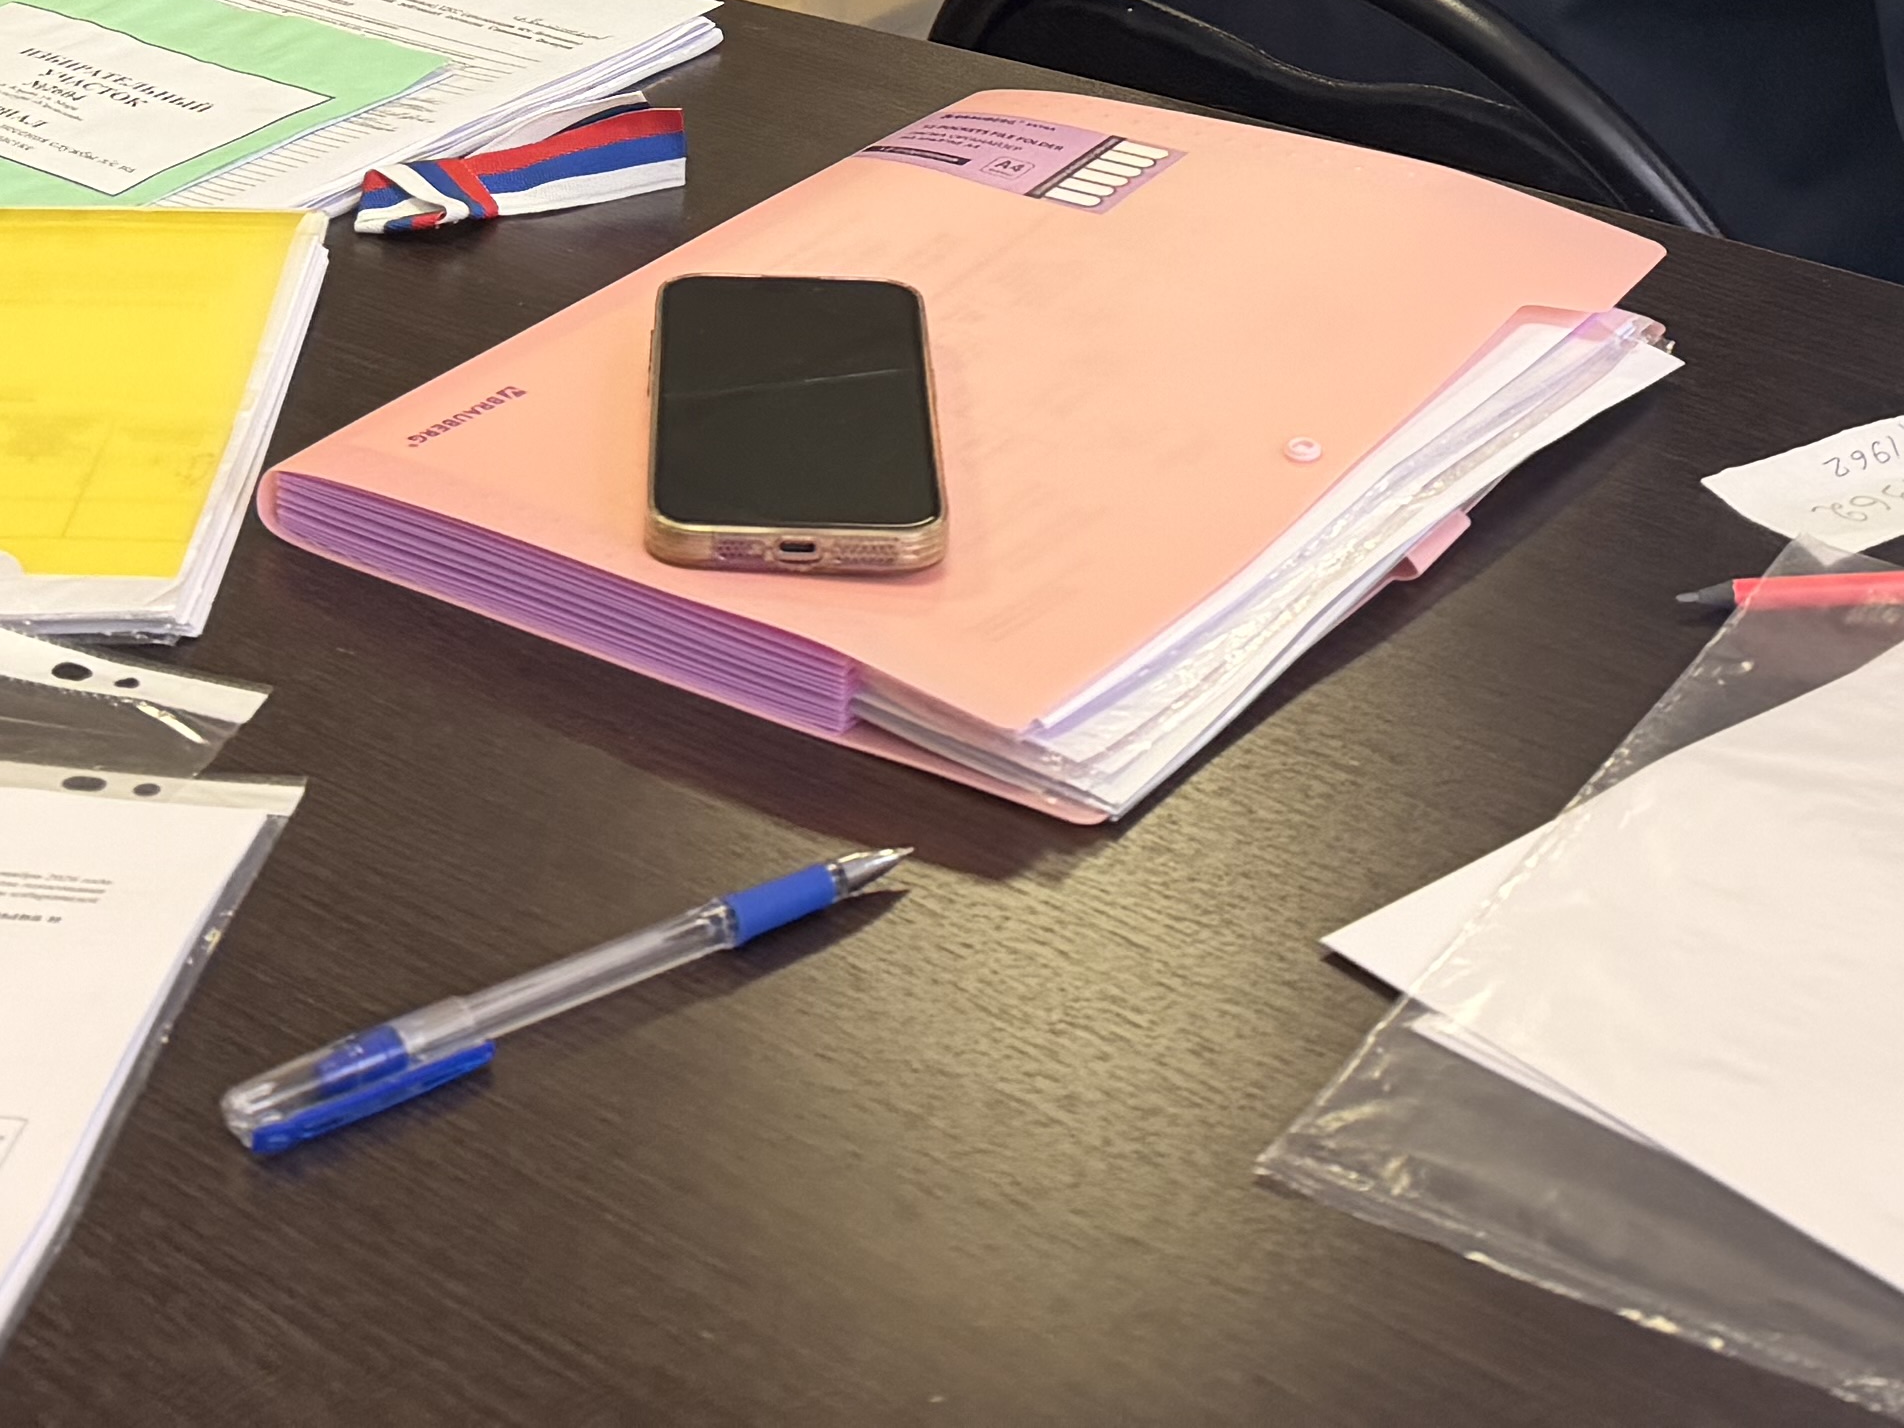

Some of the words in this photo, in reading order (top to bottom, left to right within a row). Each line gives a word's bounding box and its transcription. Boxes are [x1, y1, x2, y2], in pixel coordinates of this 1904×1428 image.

[19, 47, 213, 114] ИЗБИРАТЕЛЬНЫЙ
[39, 69, 149, 110] УЧАСТОК
[1017, 136, 1064, 152] FOLDER
[995, 159, 1026, 173] A4
[407, 396, 506, 443] BRAUBERG
